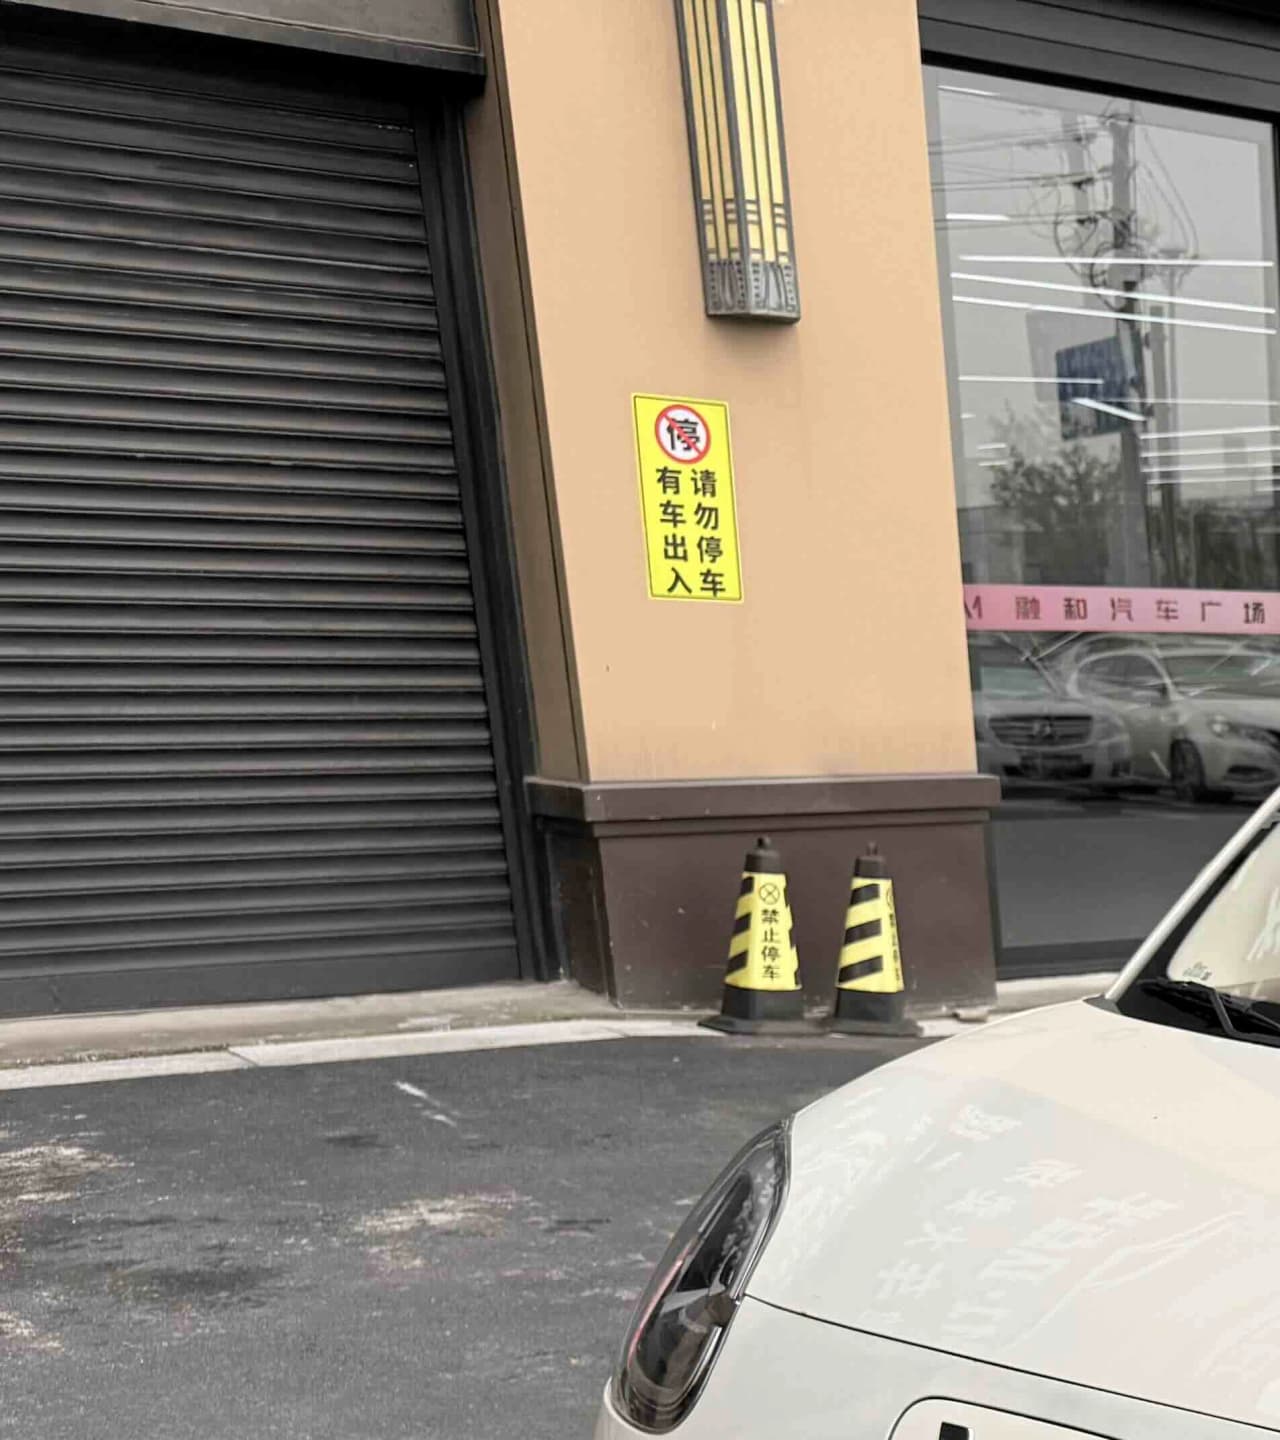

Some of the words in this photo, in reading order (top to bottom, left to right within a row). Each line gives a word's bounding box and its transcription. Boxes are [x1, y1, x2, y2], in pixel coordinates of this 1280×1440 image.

[656, 466, 692, 594] 有车出入
[690, 468, 726, 597] 请勿停车
[761, 909, 781, 981] 禁止停车
